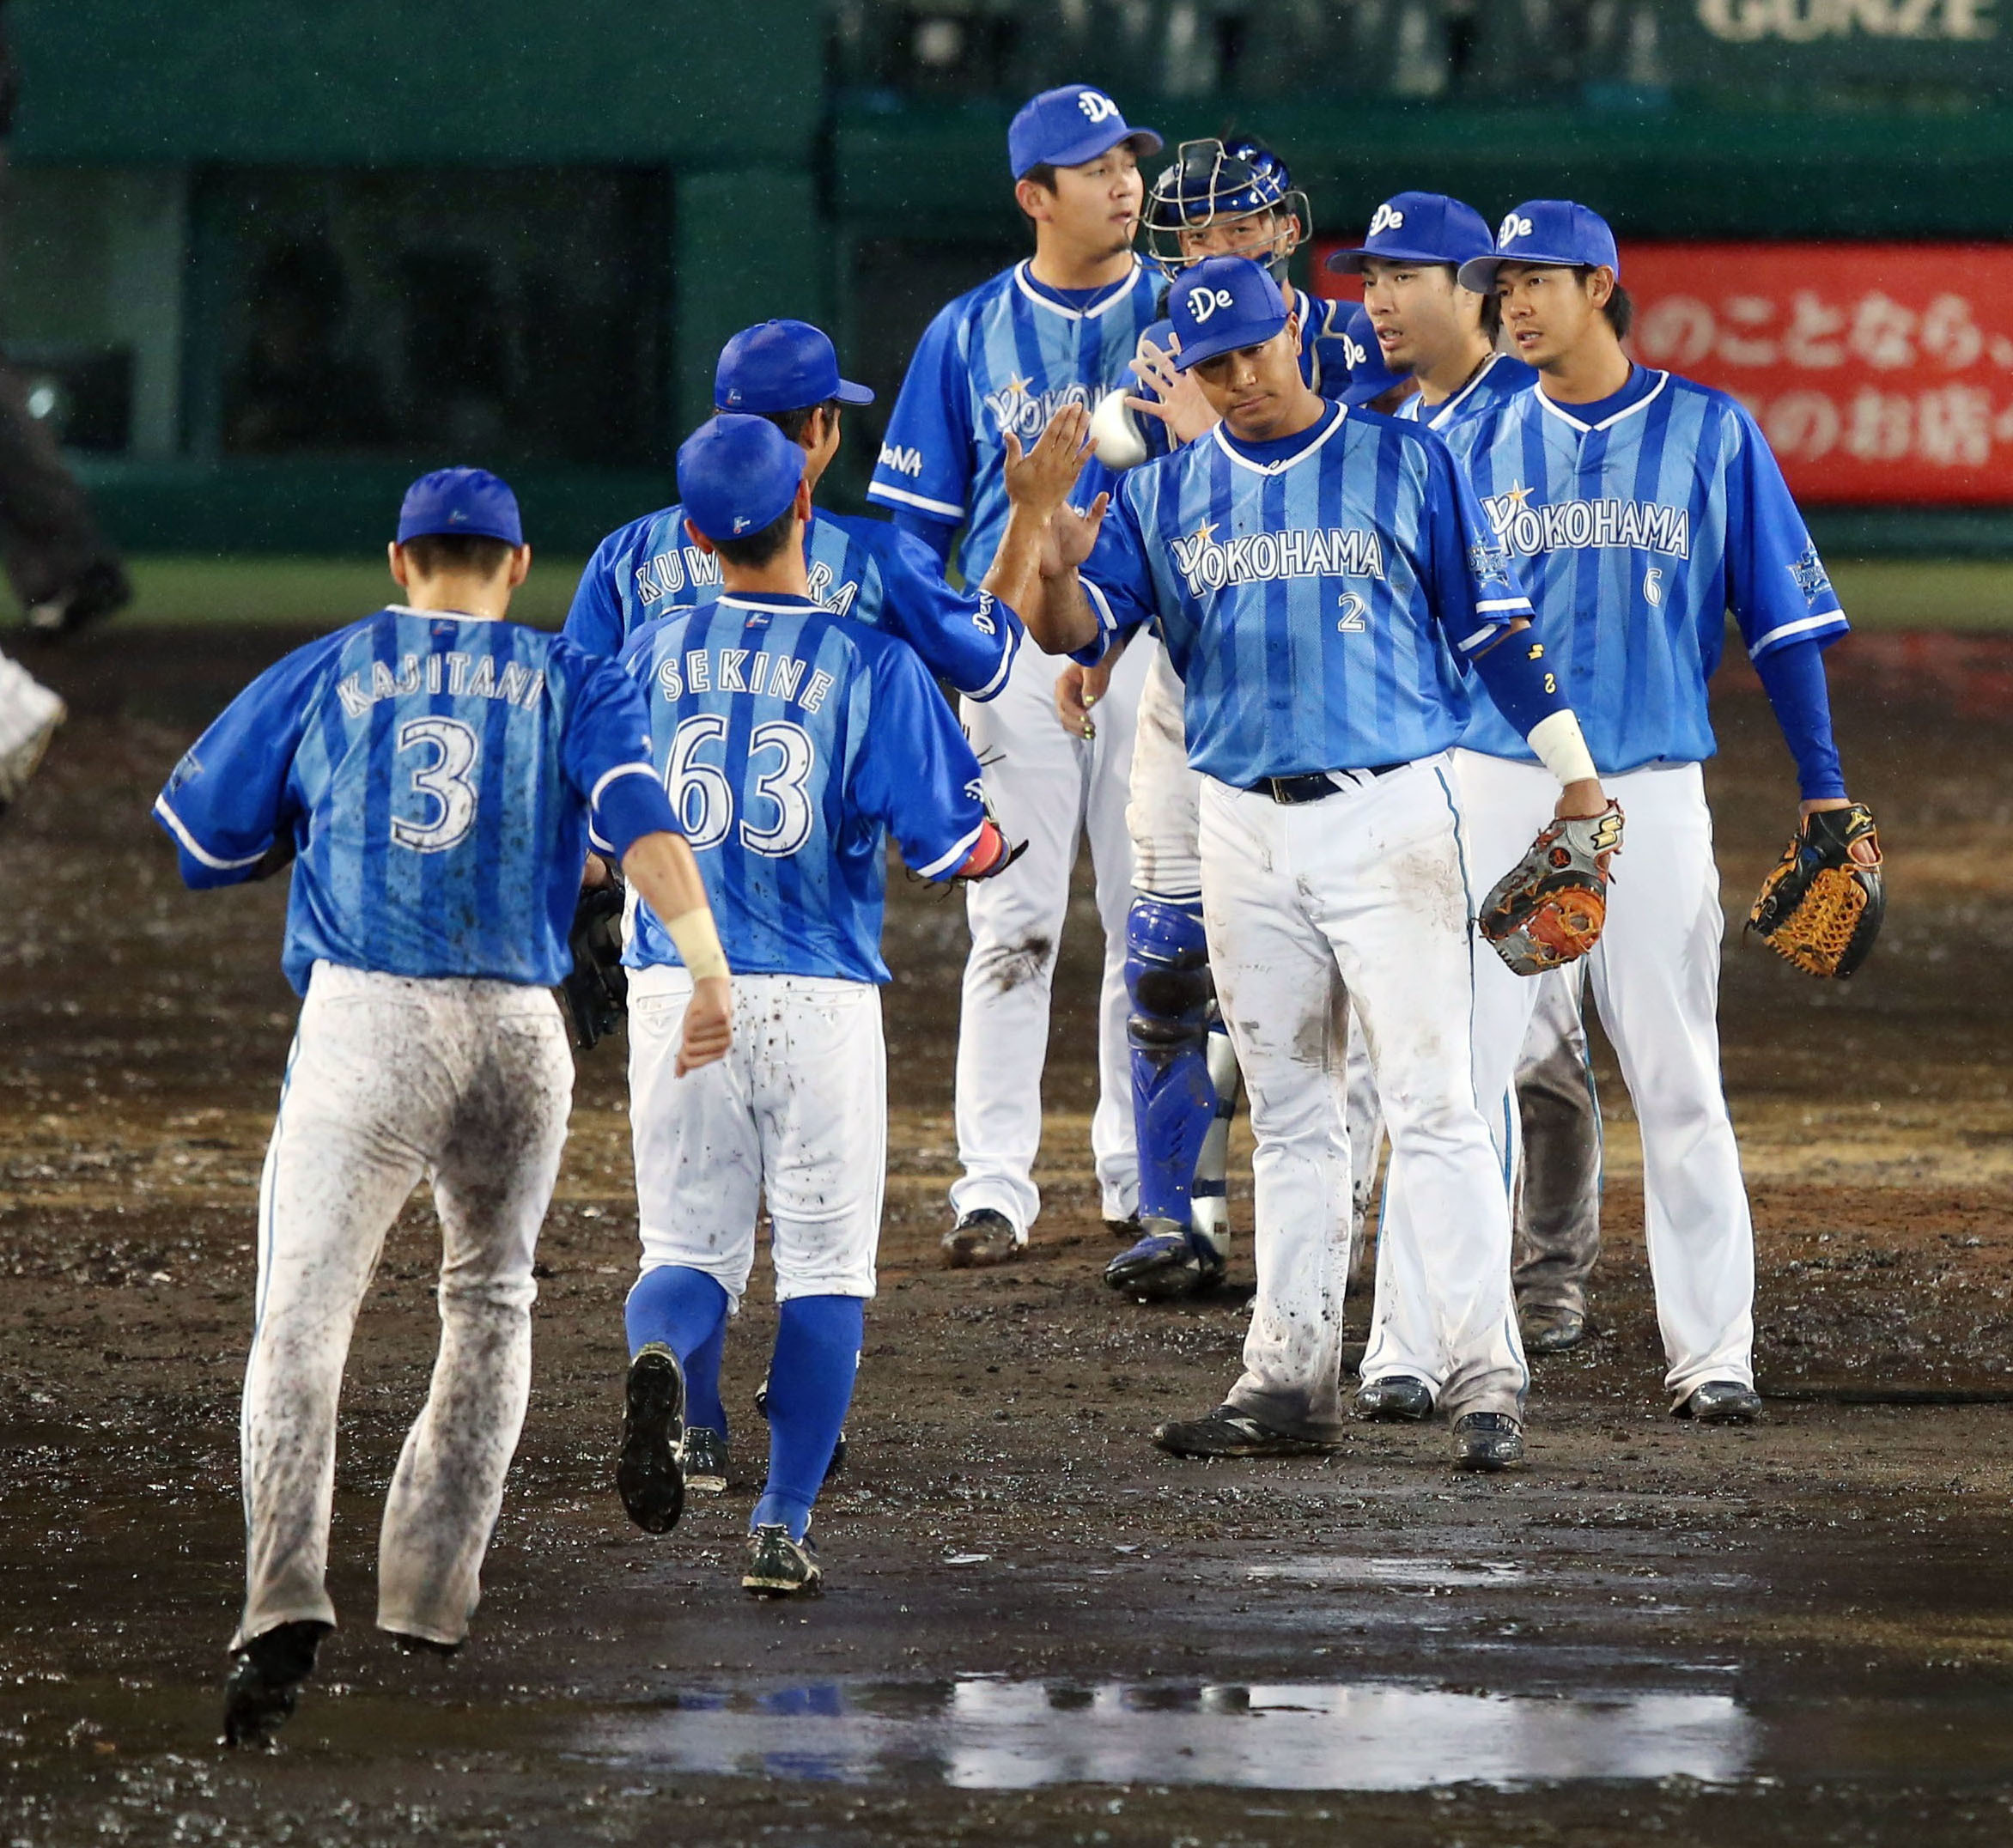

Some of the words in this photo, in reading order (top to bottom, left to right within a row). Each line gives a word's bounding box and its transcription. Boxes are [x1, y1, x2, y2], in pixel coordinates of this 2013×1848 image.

[1479, 496, 1690, 560] YOKOHAMA
[636, 544, 858, 617] KUWRA
[1169, 527, 1386, 599] YOKOHAMA
[1643, 567, 1663, 607] 6
[1337, 591, 1365, 633] 2
[337, 651, 544, 719] KAJITANI
[658, 648, 835, 714] SEKINE
[390, 714, 479, 854] 3
[664, 713, 815, 859] 63
